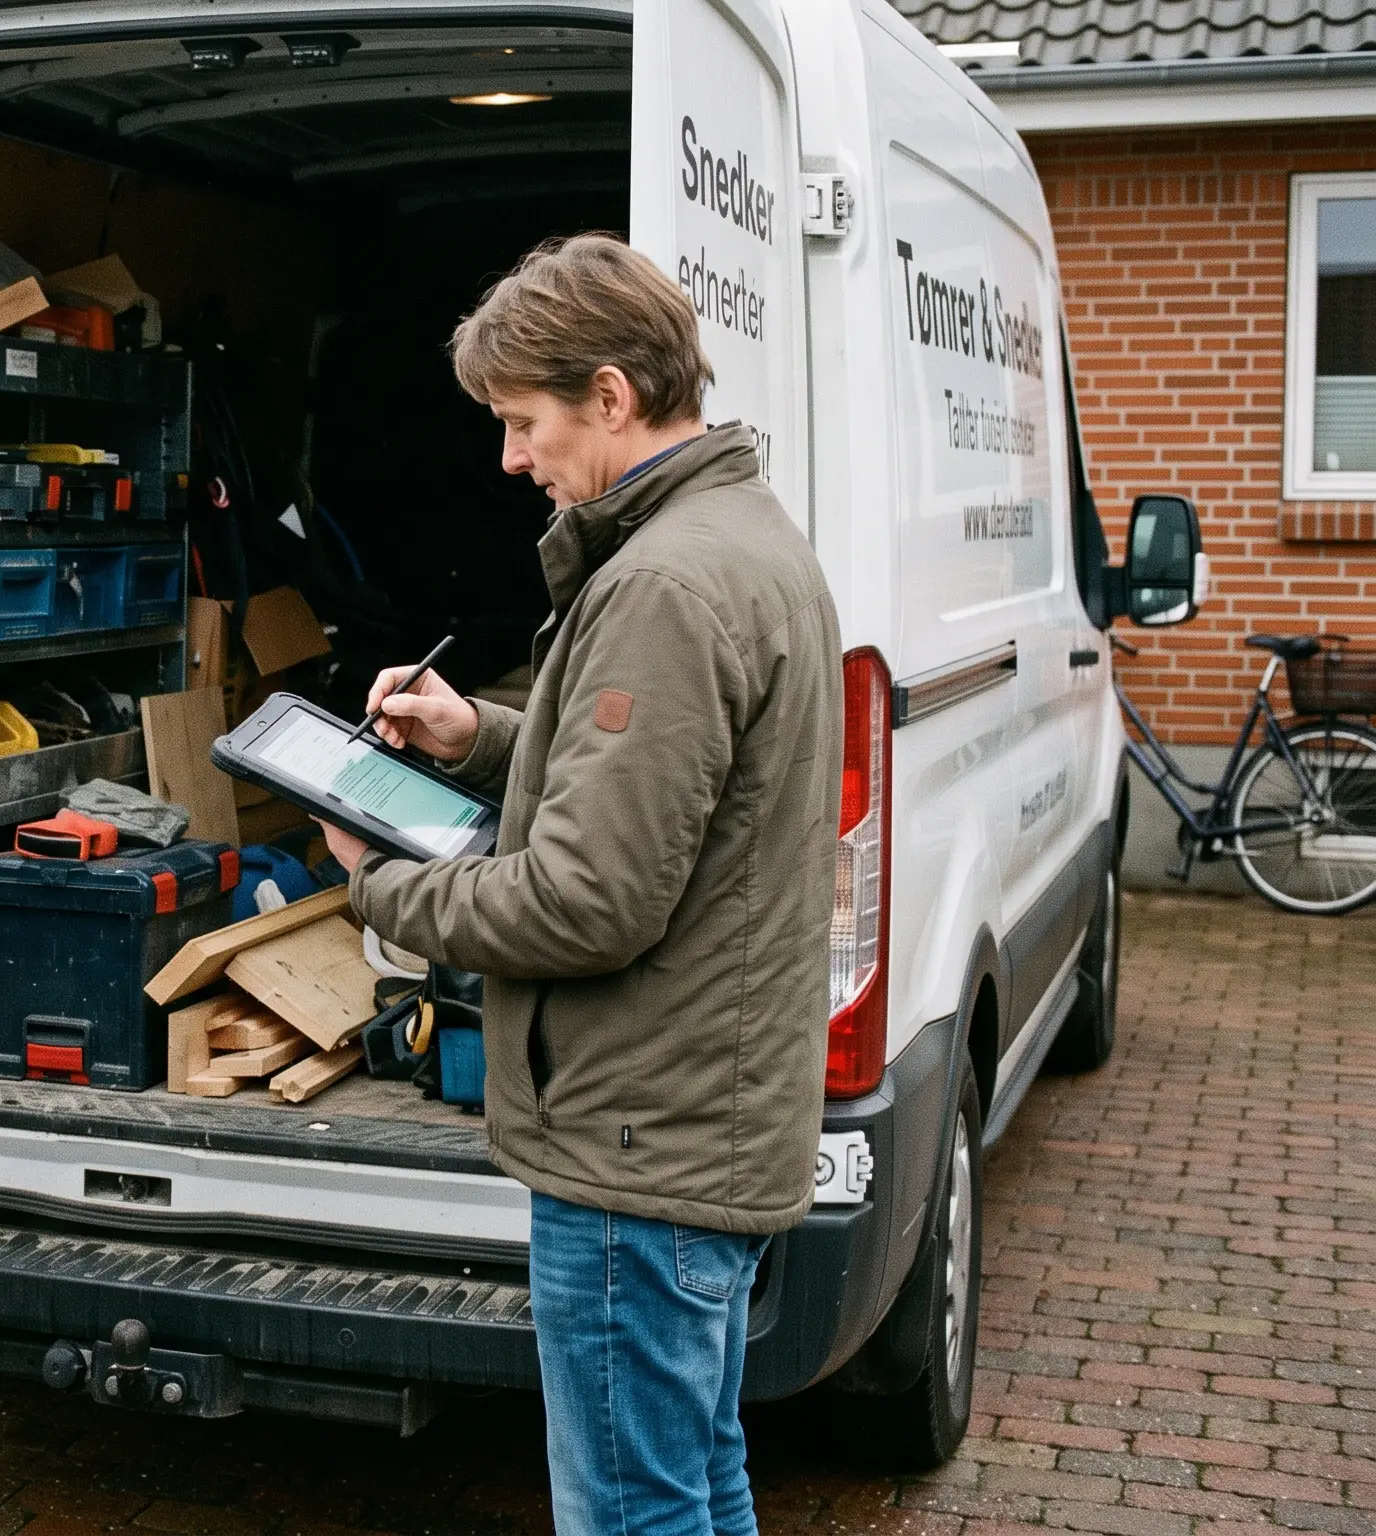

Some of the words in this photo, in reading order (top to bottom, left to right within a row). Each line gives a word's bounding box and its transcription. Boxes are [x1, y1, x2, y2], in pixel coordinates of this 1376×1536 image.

[681, 115, 774, 245] Snedker
[896, 238, 975, 358] Tømrer
[980, 277, 995, 363] &
